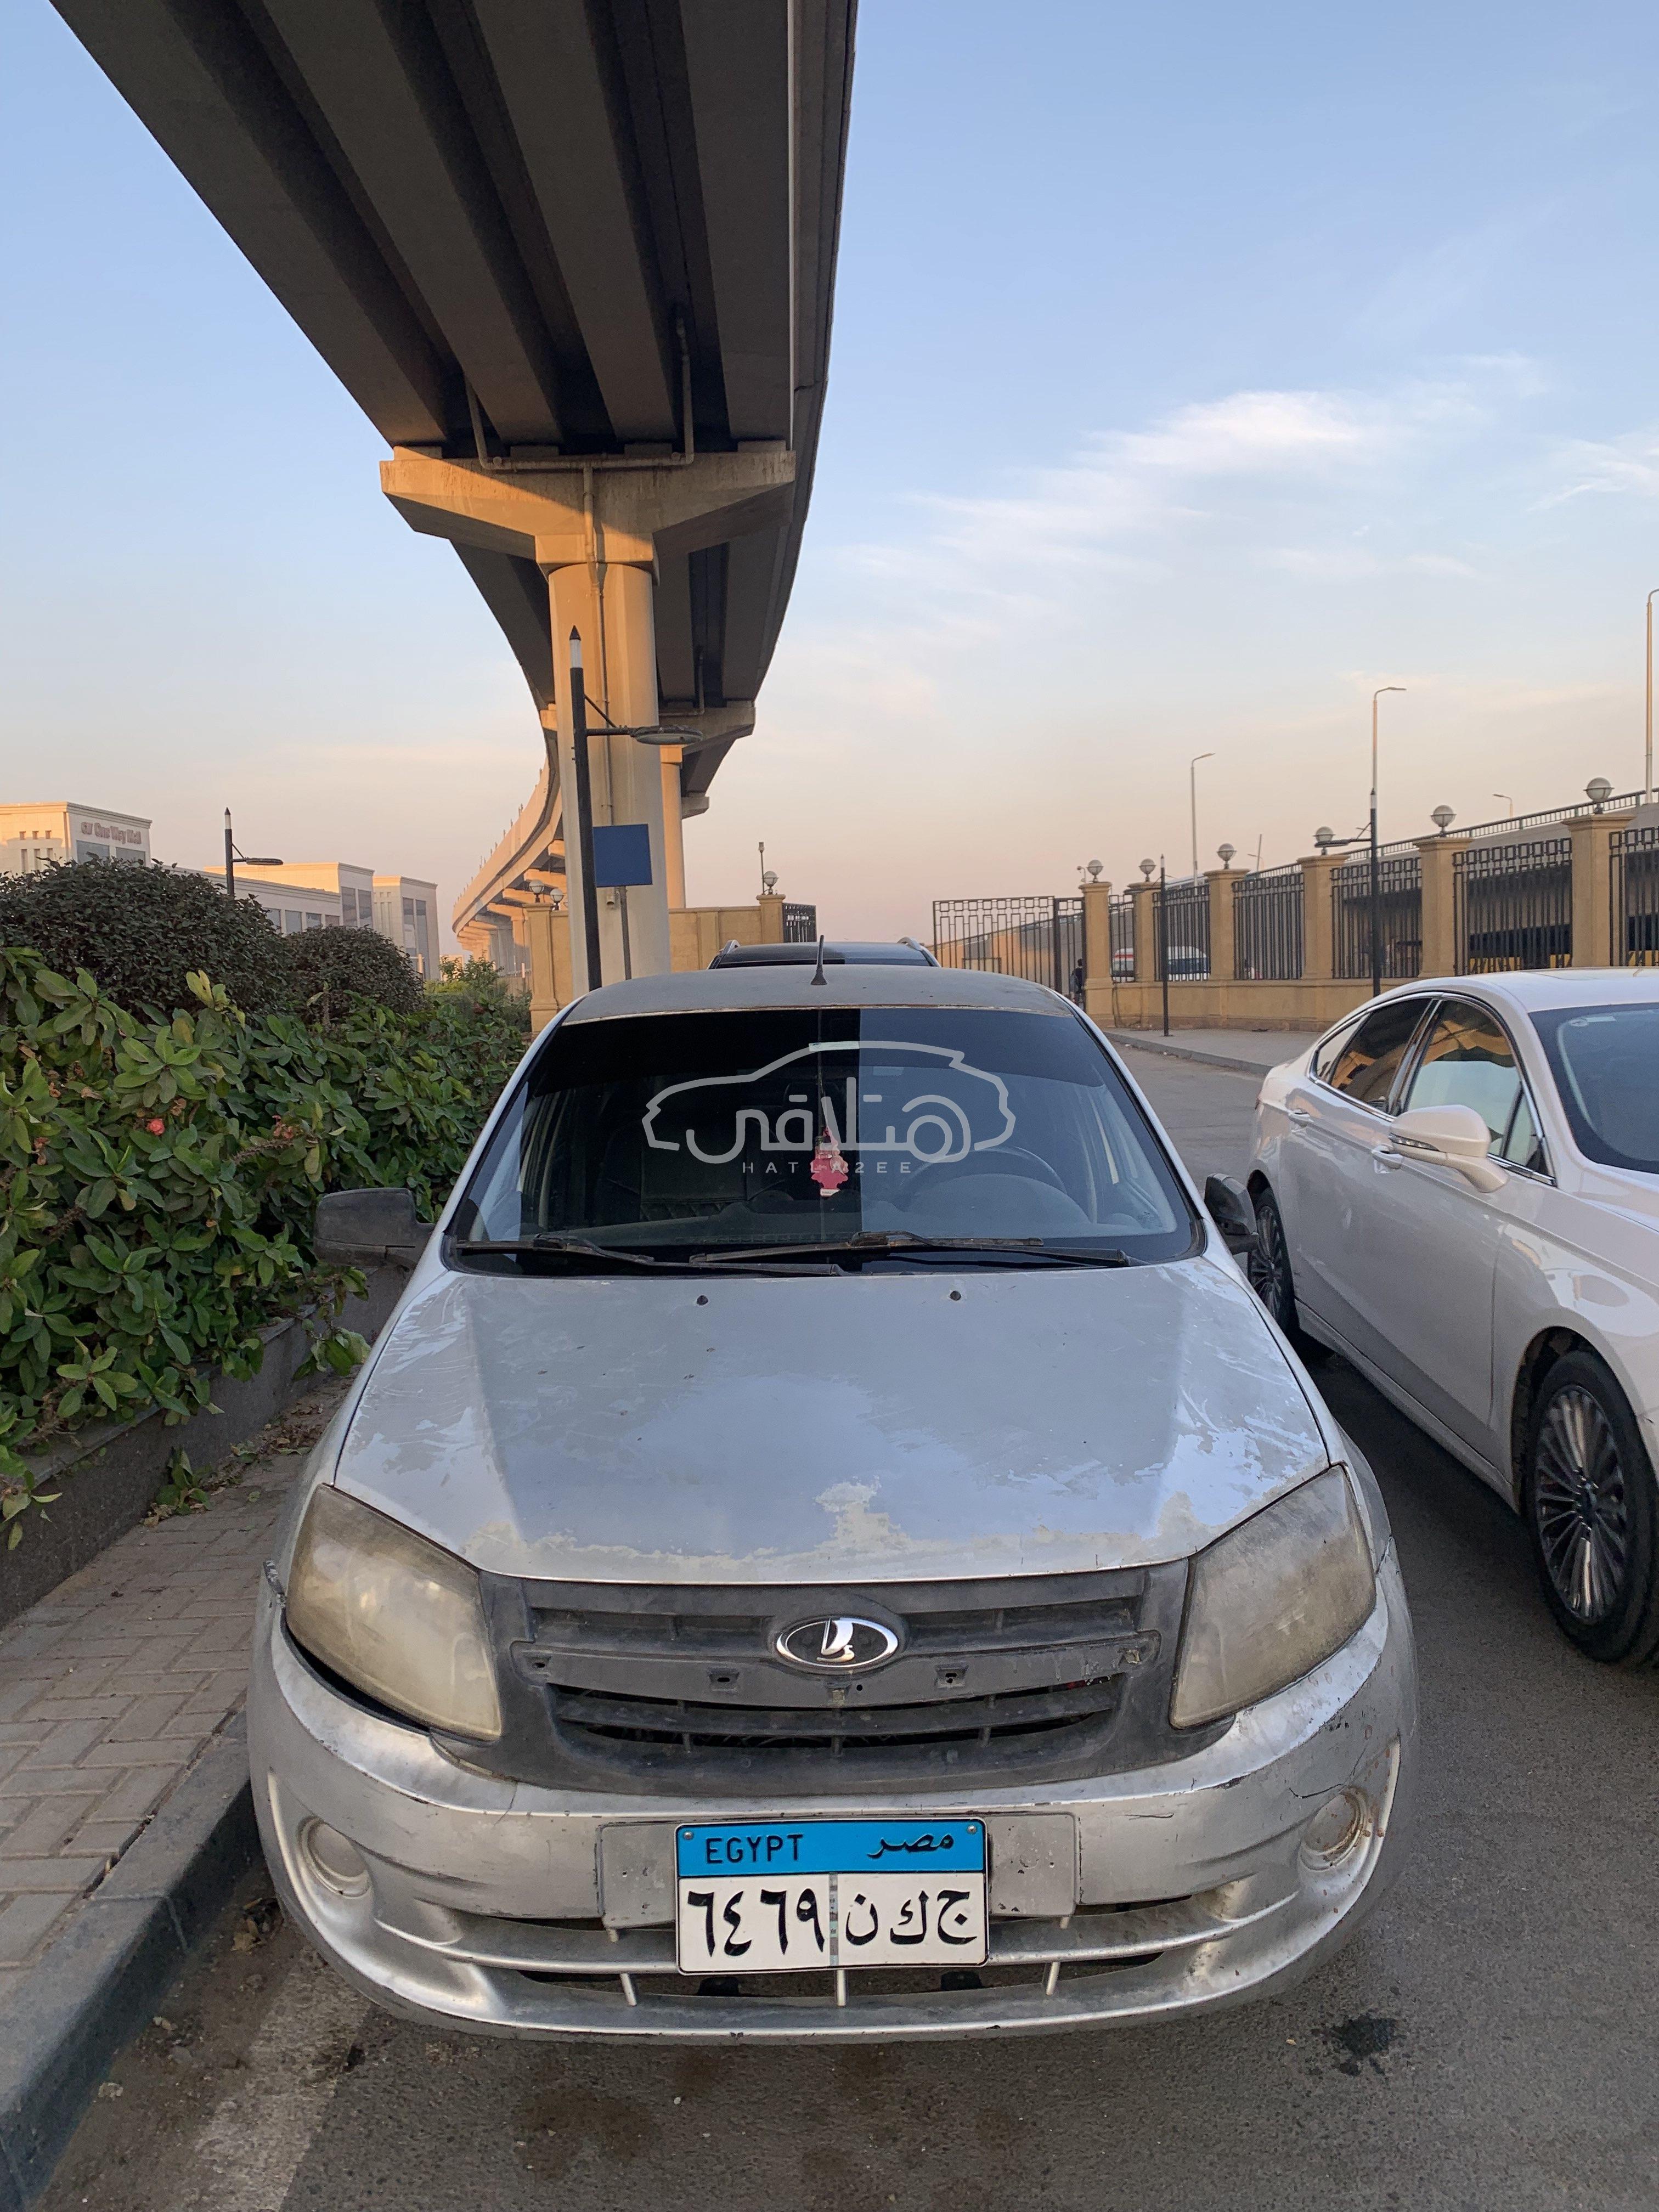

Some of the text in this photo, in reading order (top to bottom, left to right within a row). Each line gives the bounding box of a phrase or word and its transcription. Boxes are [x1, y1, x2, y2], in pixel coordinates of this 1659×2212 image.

[94, 822, 110, 838] One
[110, 826, 126, 844] Way
[127, 829, 142, 844] Mall
[706, 1833, 804, 1863] EGYPT
[866, 1832, 955, 1859] مصر
[687, 1888, 825, 1957] ٦٤٦٩
